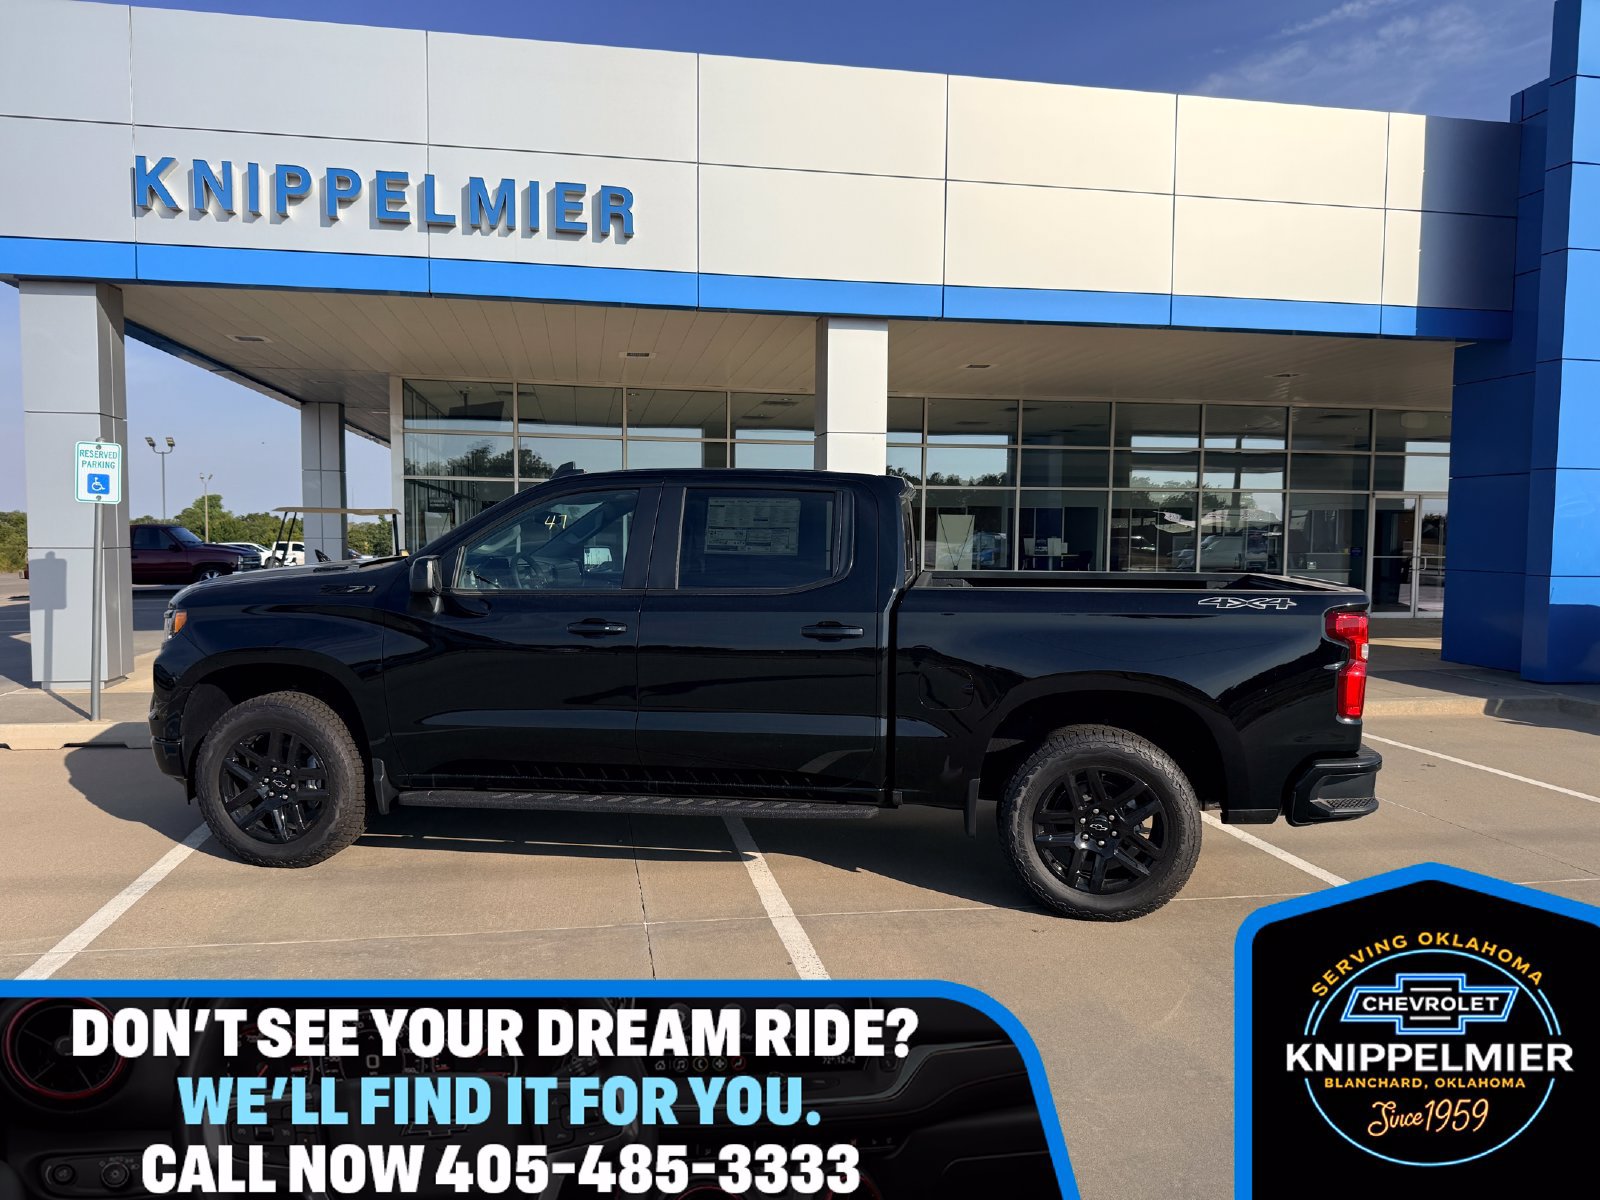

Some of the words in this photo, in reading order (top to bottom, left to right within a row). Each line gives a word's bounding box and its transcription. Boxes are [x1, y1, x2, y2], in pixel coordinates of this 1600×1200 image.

[134, 155, 634, 238] KNIPPELMIER
[79, 449, 118, 459] RESERVED
[81, 459, 116, 469] PARKING
[544, 514, 567, 530] 47
